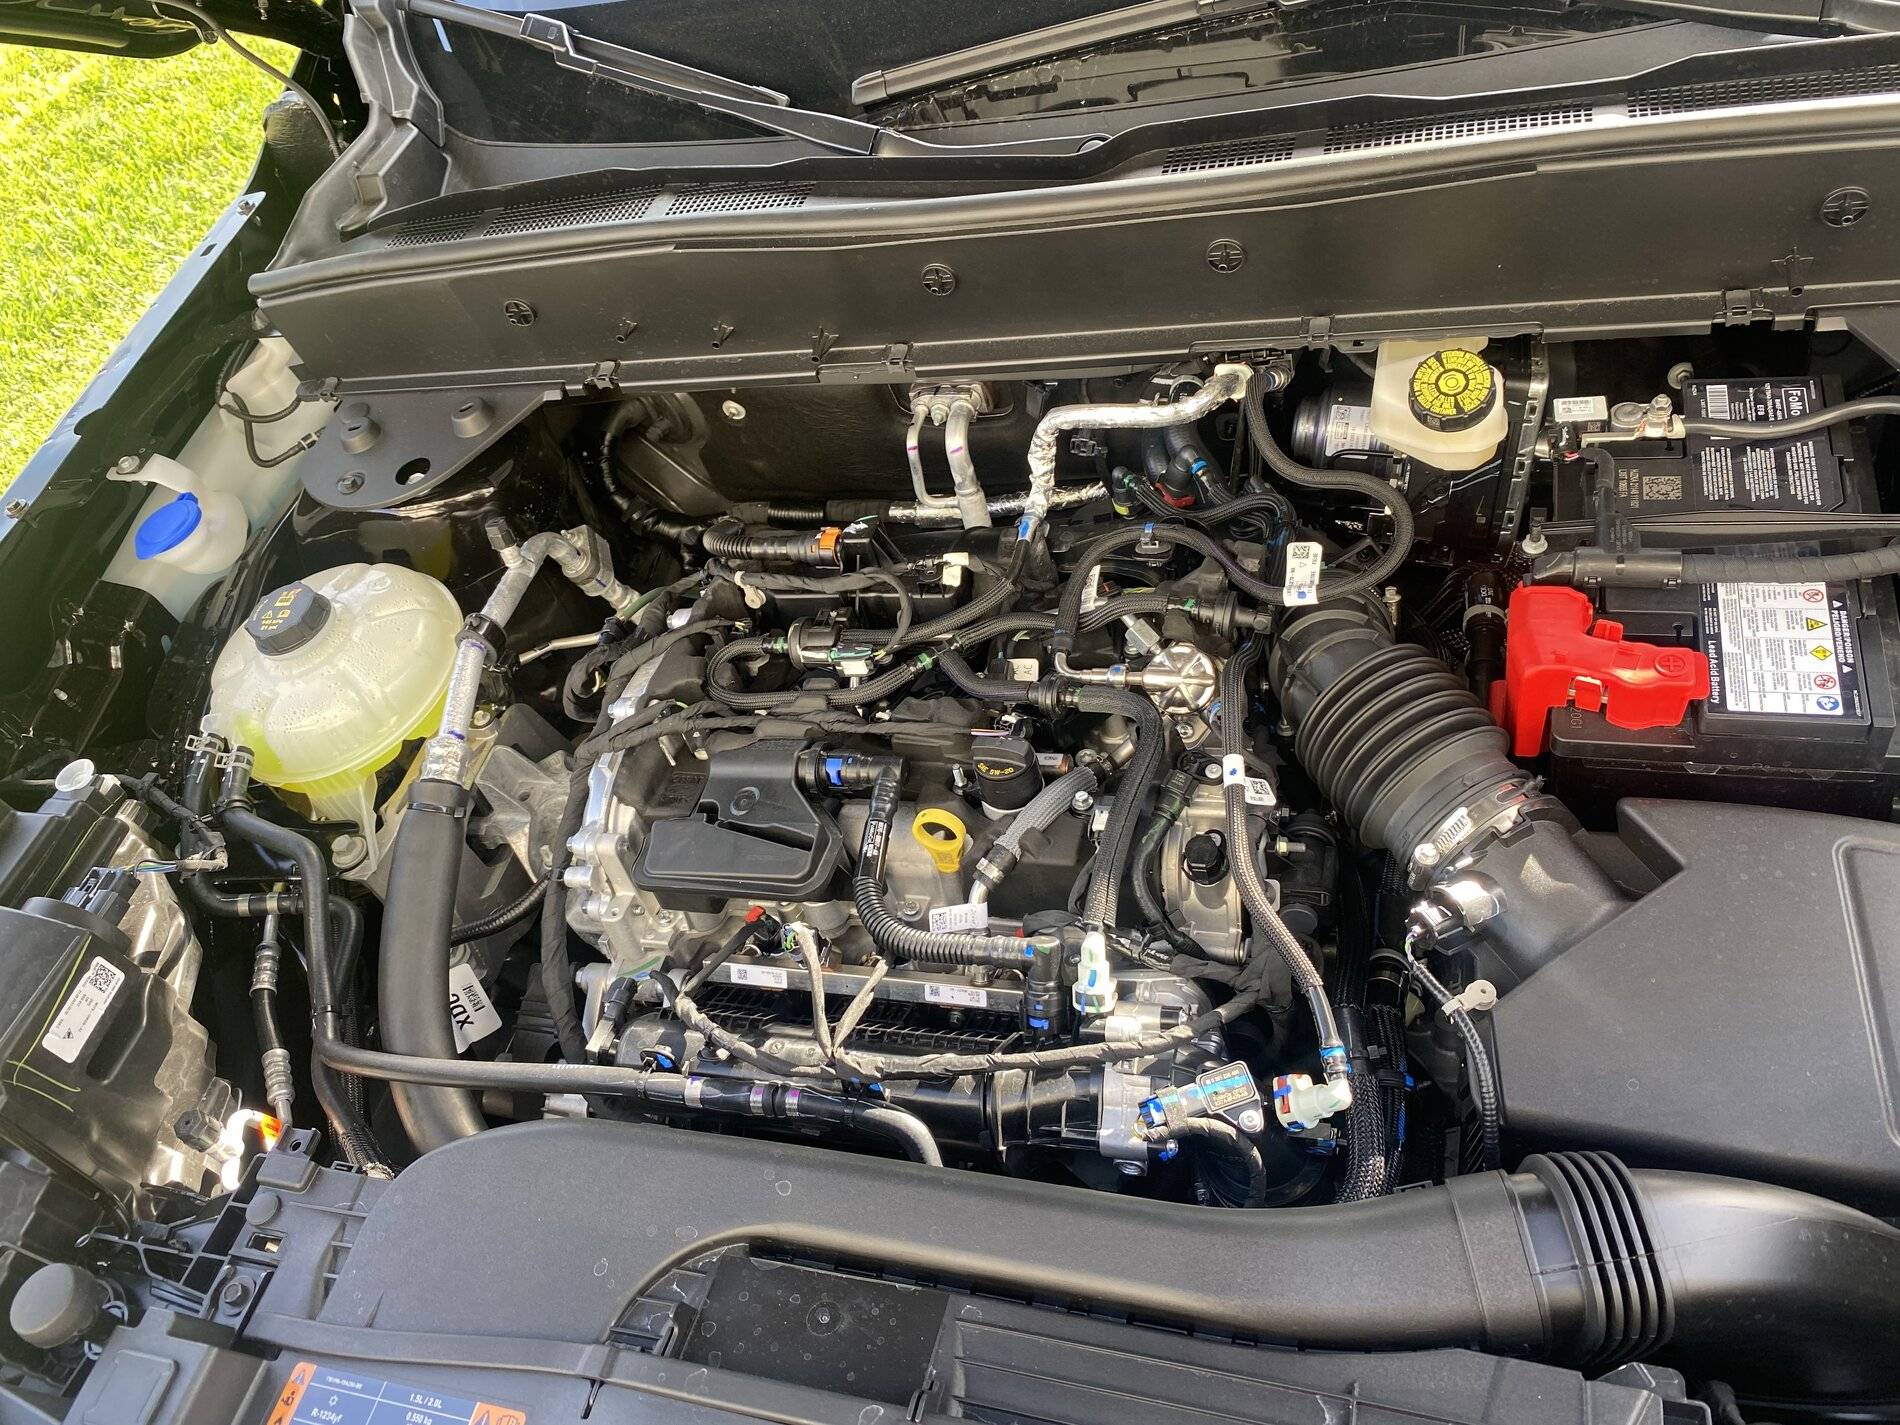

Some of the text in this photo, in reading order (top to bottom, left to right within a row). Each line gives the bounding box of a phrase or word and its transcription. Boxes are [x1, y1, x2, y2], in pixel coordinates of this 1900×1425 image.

[1839, 610, 1854, 664] DANGER/POISON
[1708, 640, 1718, 658] Lead
[1710, 659, 1720, 675] Acid
[1709, 676, 1722, 704] Battery
[428, 1397, 442, 1408] 2.0L
[310, 1407, 343, 1423] R-1234yf
